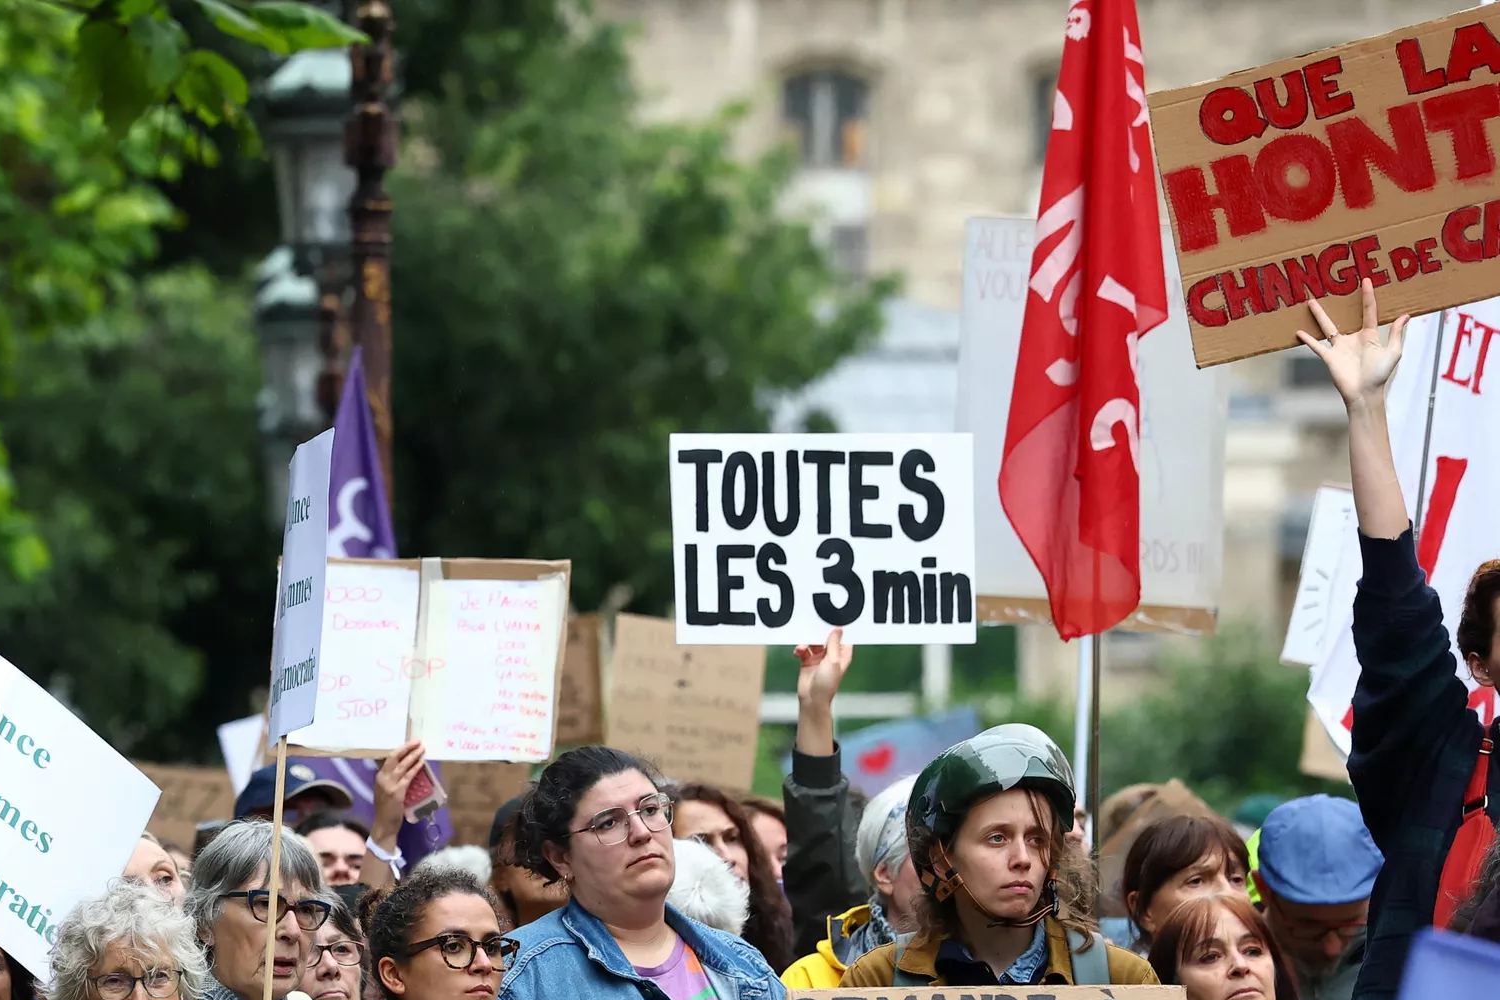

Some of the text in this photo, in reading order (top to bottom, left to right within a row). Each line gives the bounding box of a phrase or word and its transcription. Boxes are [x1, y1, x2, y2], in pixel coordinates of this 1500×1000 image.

[1198, 22, 1500, 145] QUE LA
[1163, 83, 1500, 253] HONT
[1187, 235, 1391, 327] CHANGE
[1388, 237, 1442, 282] DE
[1442, 312, 1500, 394] ET
[678, 449, 945, 541] TOUTES
[684, 538, 972, 628] LES 3 min
[335, 698, 388, 720] STOP
